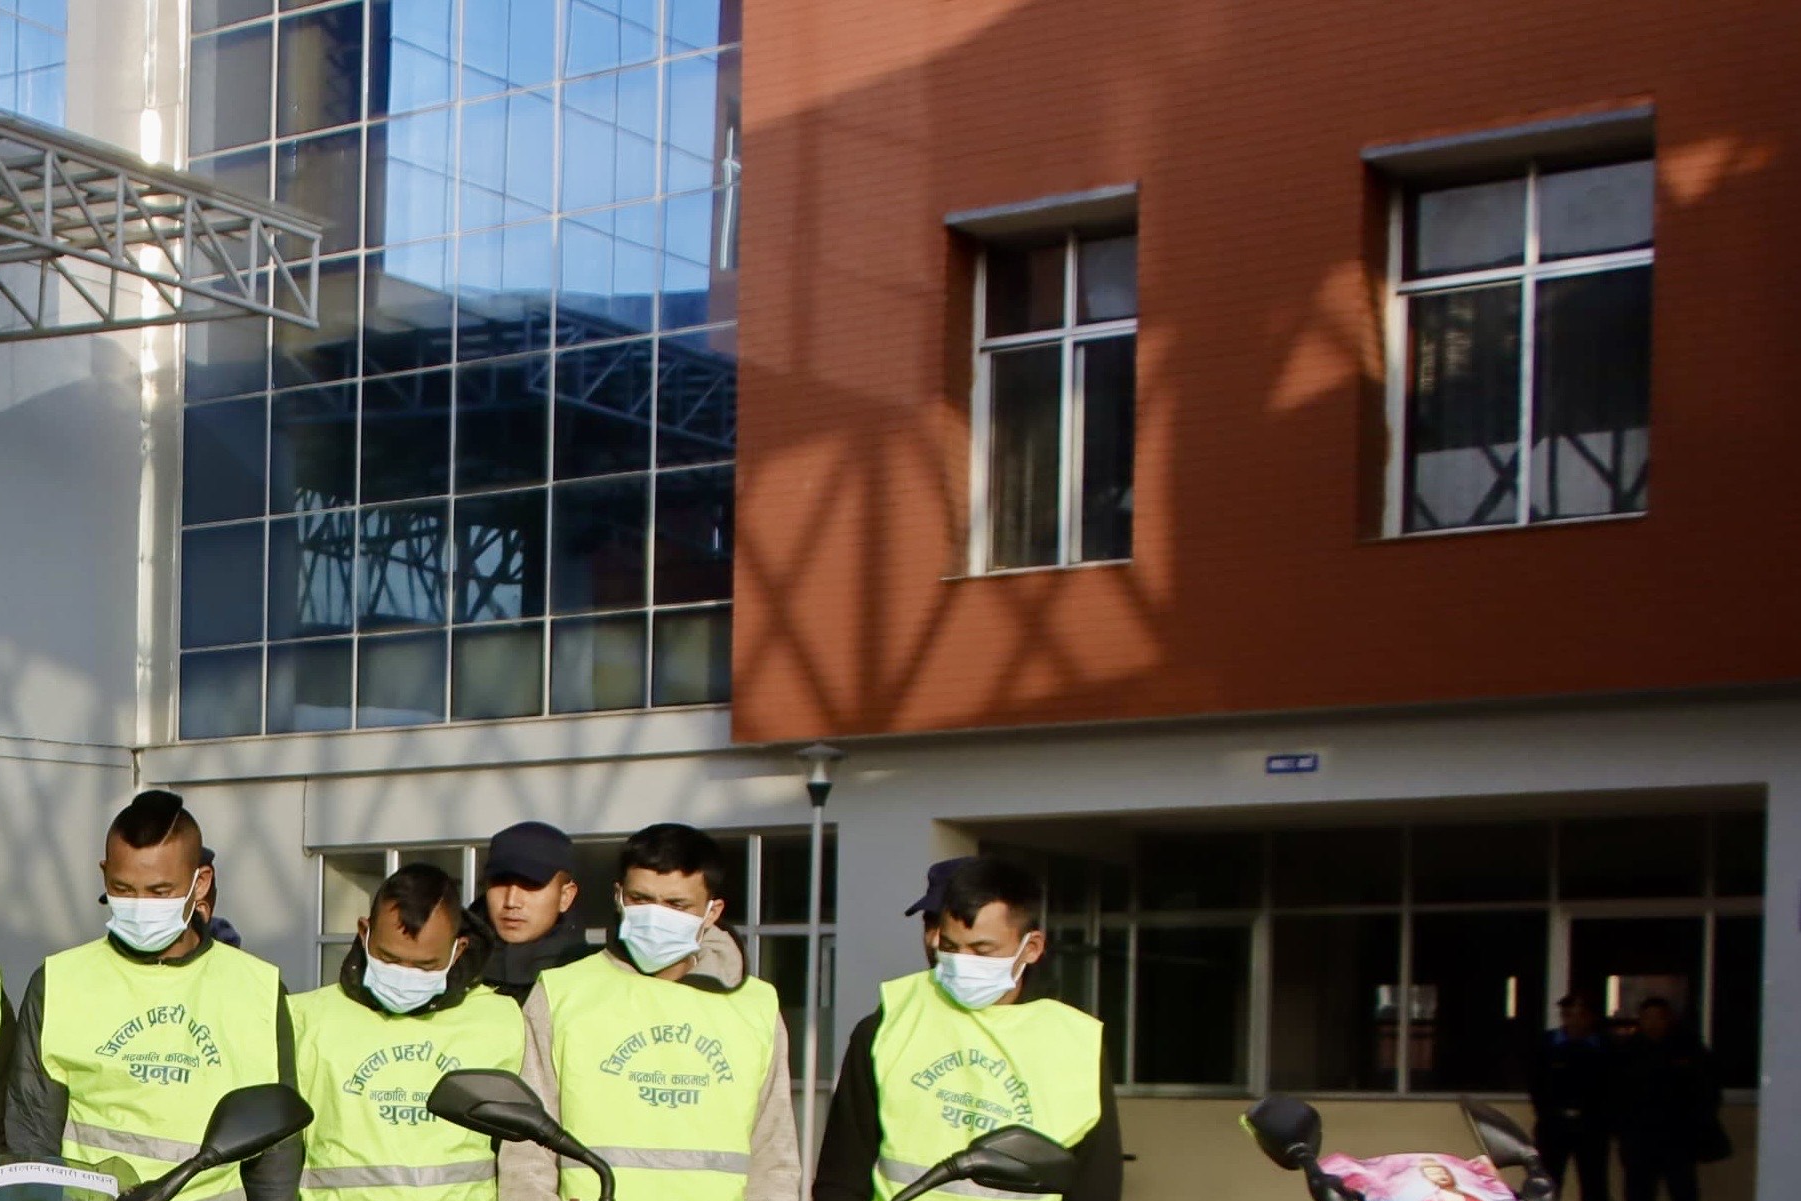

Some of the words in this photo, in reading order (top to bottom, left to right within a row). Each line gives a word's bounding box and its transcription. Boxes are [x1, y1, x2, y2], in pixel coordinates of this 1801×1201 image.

[95, 1015, 145, 1058] जिल्ला
[147, 1003, 186, 1027] प्रहरी
[187, 1017, 221, 1067] परिसर
[599, 1031, 647, 1076] जिल्ला
[650, 1023, 693, 1045] प्रहरी
[695, 1035, 734, 1084] परिसर
[129, 1062, 192, 1085] थुनुवा
[343, 1049, 389, 1096] जिल्ला
[391, 1040, 435, 1063] प्रहरी
[639, 1086, 701, 1108] थुनुवा
